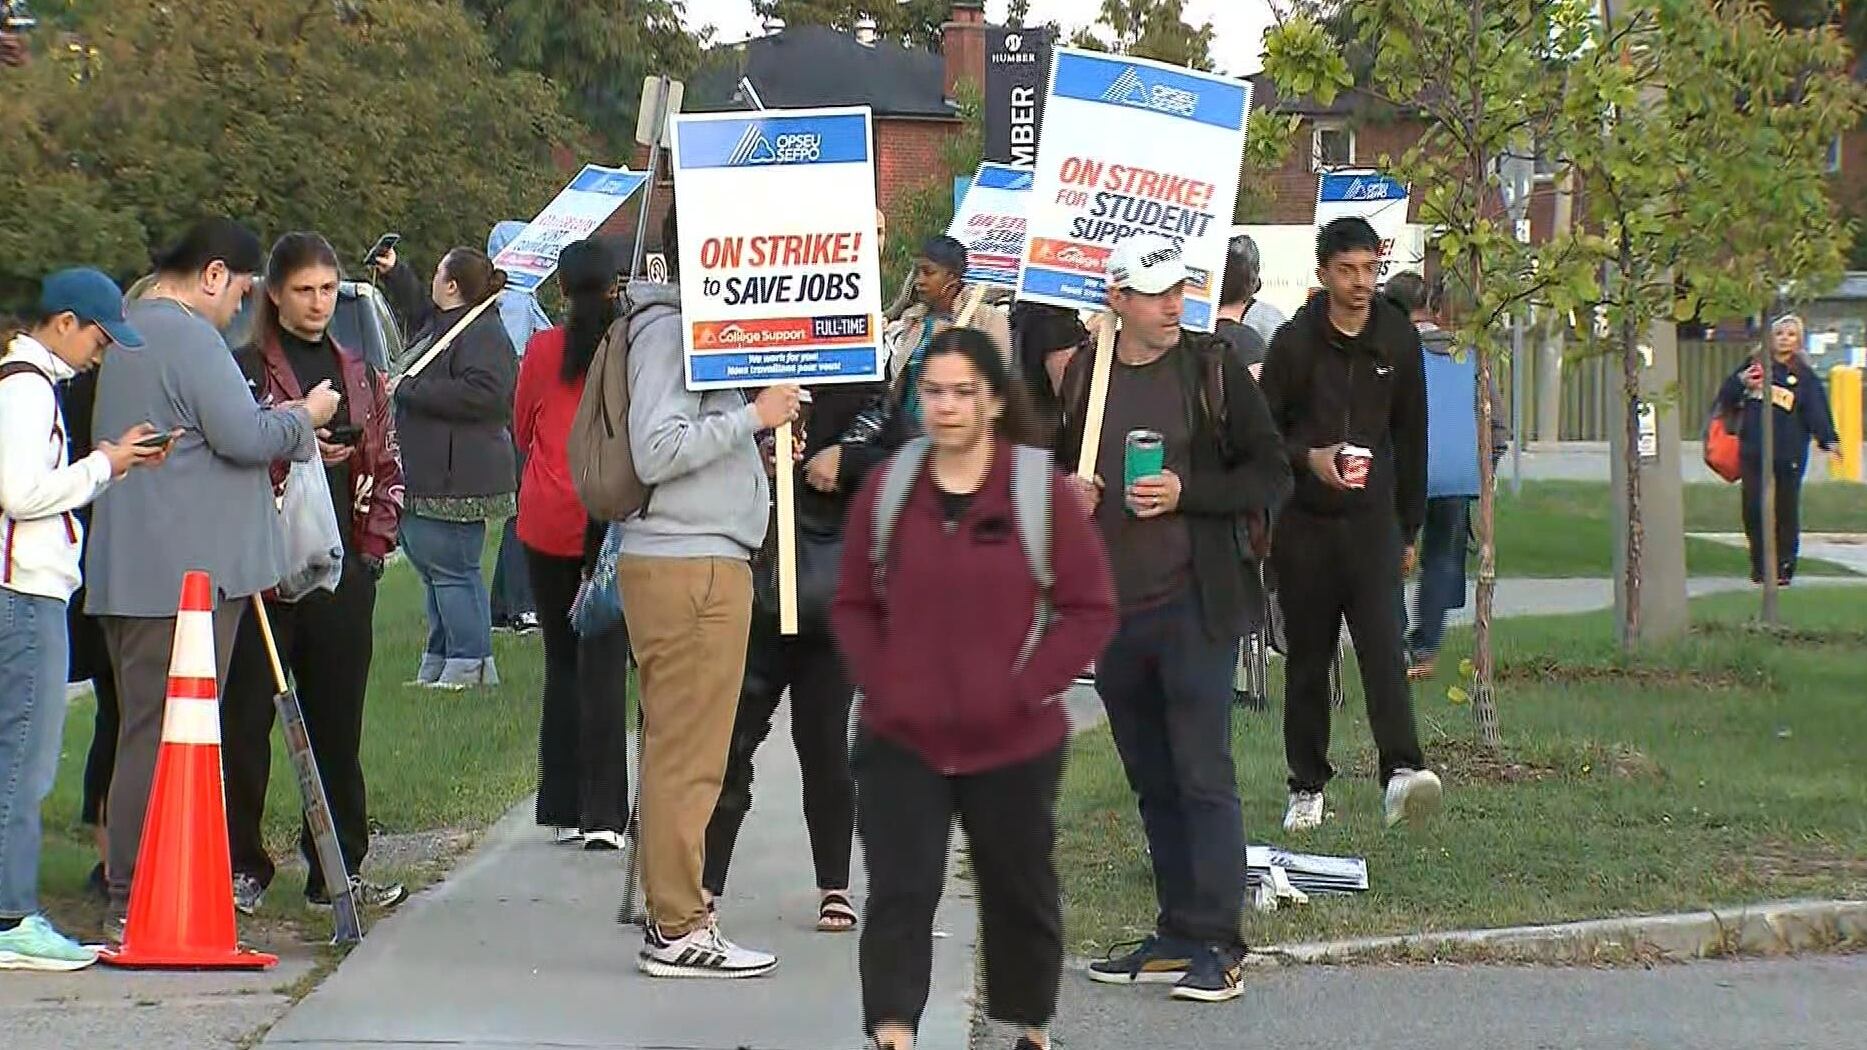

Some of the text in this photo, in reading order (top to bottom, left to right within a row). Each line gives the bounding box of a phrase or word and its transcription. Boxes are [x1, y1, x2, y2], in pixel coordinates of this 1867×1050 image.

[992, 53, 1035, 62] HUMBER
[776, 133, 821, 148] OPSEU
[776, 147, 820, 162] SEFPO
[1059, 155, 1216, 210] ON STRIKE!
[1055, 188, 1216, 238] FOR STUDENT
[1069, 216, 1185, 252] SUPPS
[700, 231, 862, 269] ON STRIKE!
[703, 272, 861, 305] to SAVE JOBS
[719, 326, 805, 345] College Support
[815, 317, 867, 336] FULL-TIME
